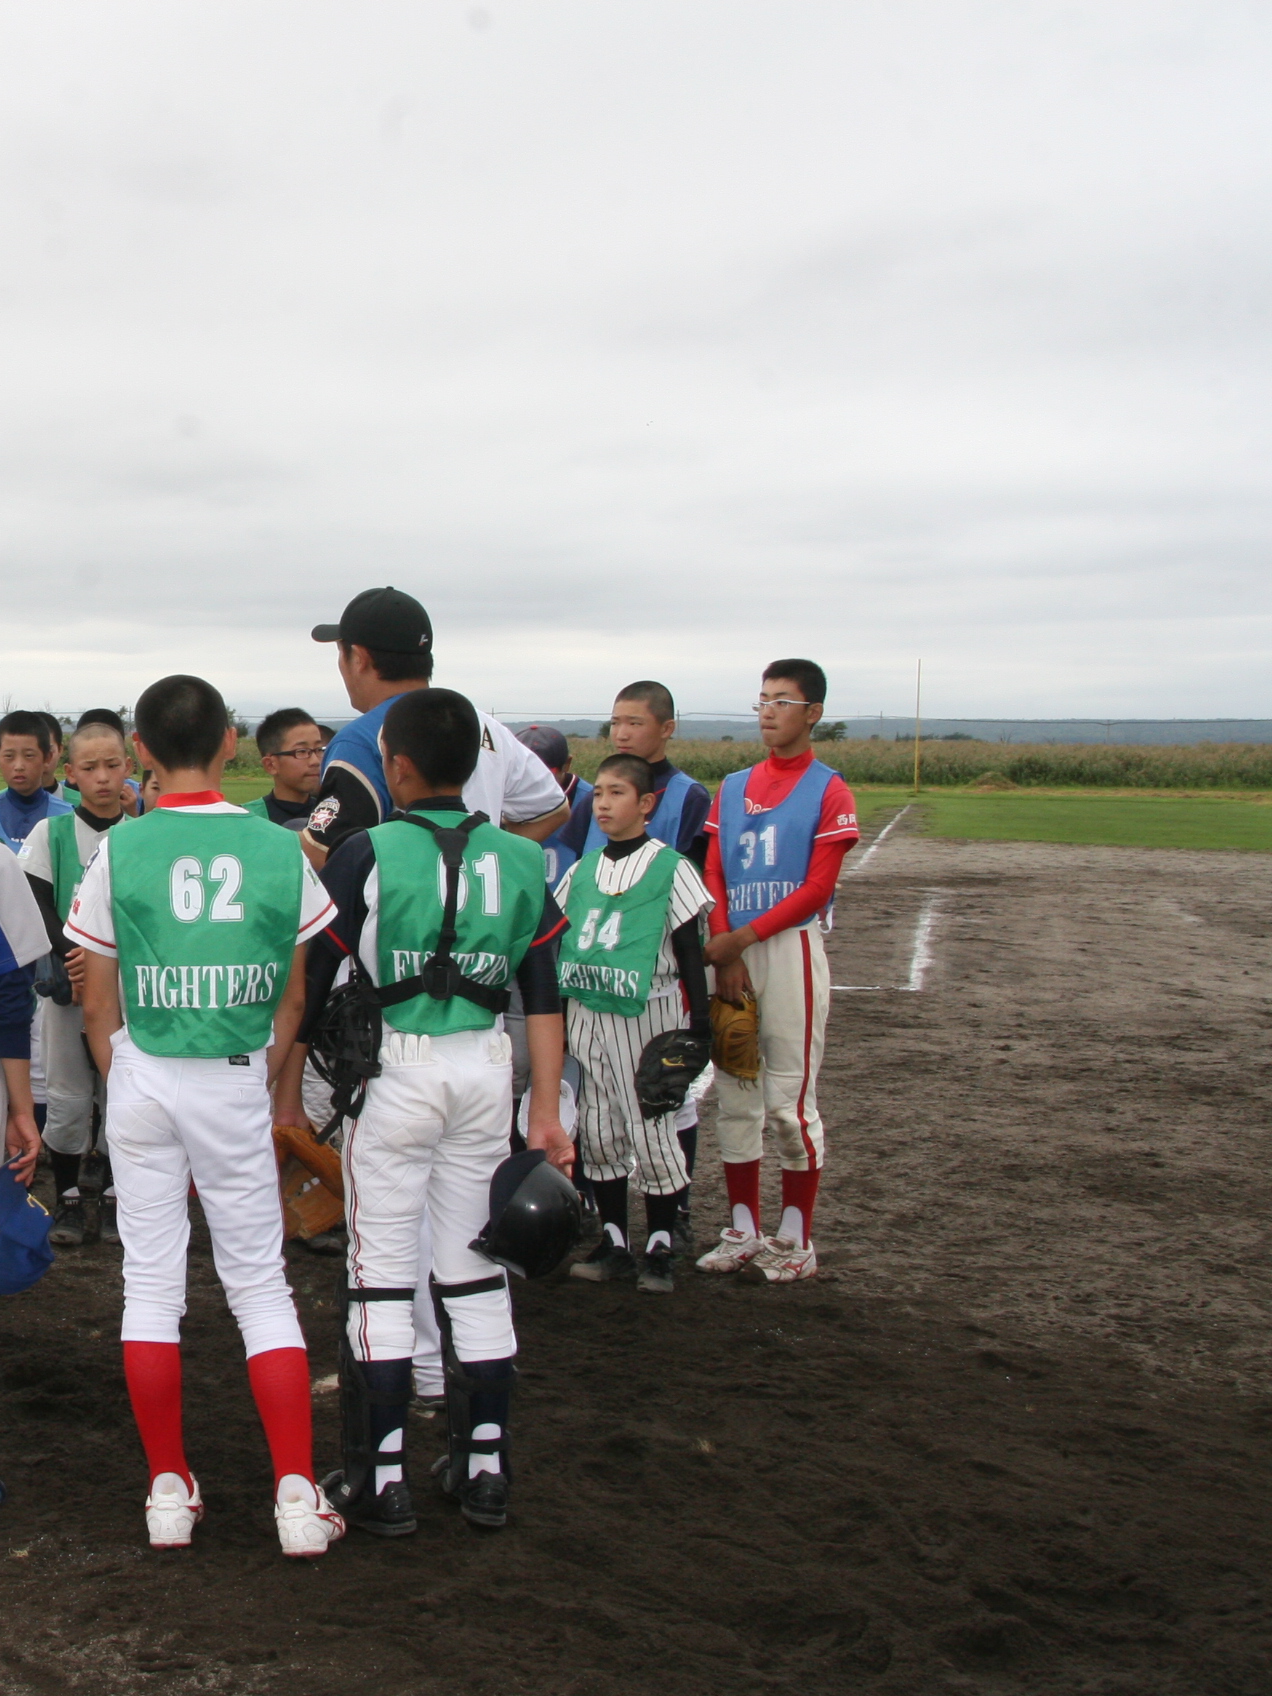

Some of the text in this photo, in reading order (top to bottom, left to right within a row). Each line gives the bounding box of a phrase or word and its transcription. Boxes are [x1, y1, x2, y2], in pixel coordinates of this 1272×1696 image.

[738, 824, 777, 870] 31
[168, 854, 244, 923] 62
[577, 907, 624, 951] 54
[134, 961, 277, 1009] FIGHTERS
